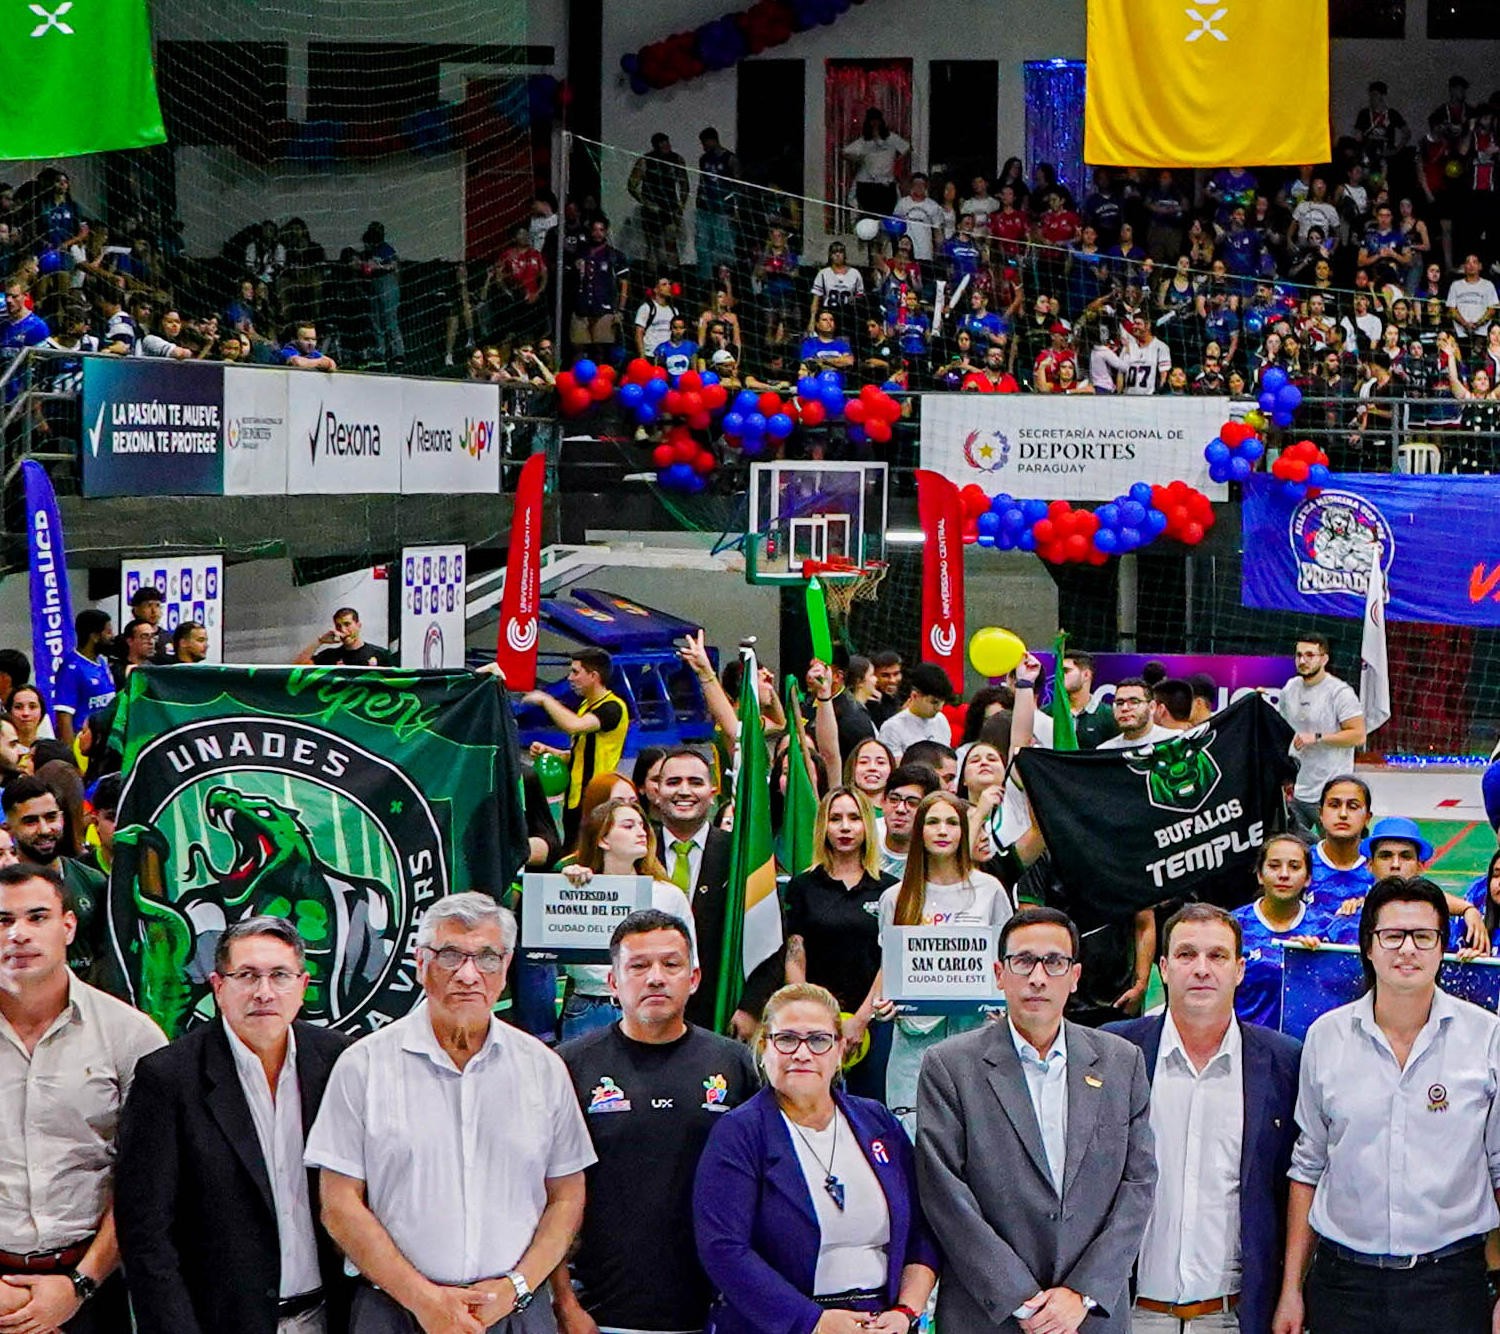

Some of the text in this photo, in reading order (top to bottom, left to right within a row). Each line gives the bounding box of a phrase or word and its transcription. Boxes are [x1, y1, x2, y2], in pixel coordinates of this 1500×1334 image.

[112, 403, 127, 425] LA
[129, 399, 167, 426] PASIÓN
[168, 405, 181, 426] TE
[112, 431, 217, 453] REXONA TE PROTEGE
[326, 412, 381, 457] Rexona
[416, 423, 453, 453] Rexona
[1018, 426, 1184, 441] SECRETARÍA NACIONAL DE
[1018, 442, 1136, 461] DEPORTES
[1017, 462, 1086, 475] PARAGUAY
[939, 517, 952, 620] UNIVERSIDAD CENTRAL
[166, 731, 351, 779] UNADES
[1153, 797, 1243, 850] BUFALOS
[1146, 820, 1264, 889] TEMPLE
[559, 890, 619, 902] UNIVERSIDAD
[545, 904, 632, 916] NACIONAL DEL ESTE
[549, 923, 604, 933] CIUDAD DEL
[908, 938, 987, 951] UNIVERSIDAD
[912, 957, 983, 972] SAN CARLOS
[908, 975, 987, 983] CIUDAD DEL ESTE
[652, 1098, 673, 1108] UX
